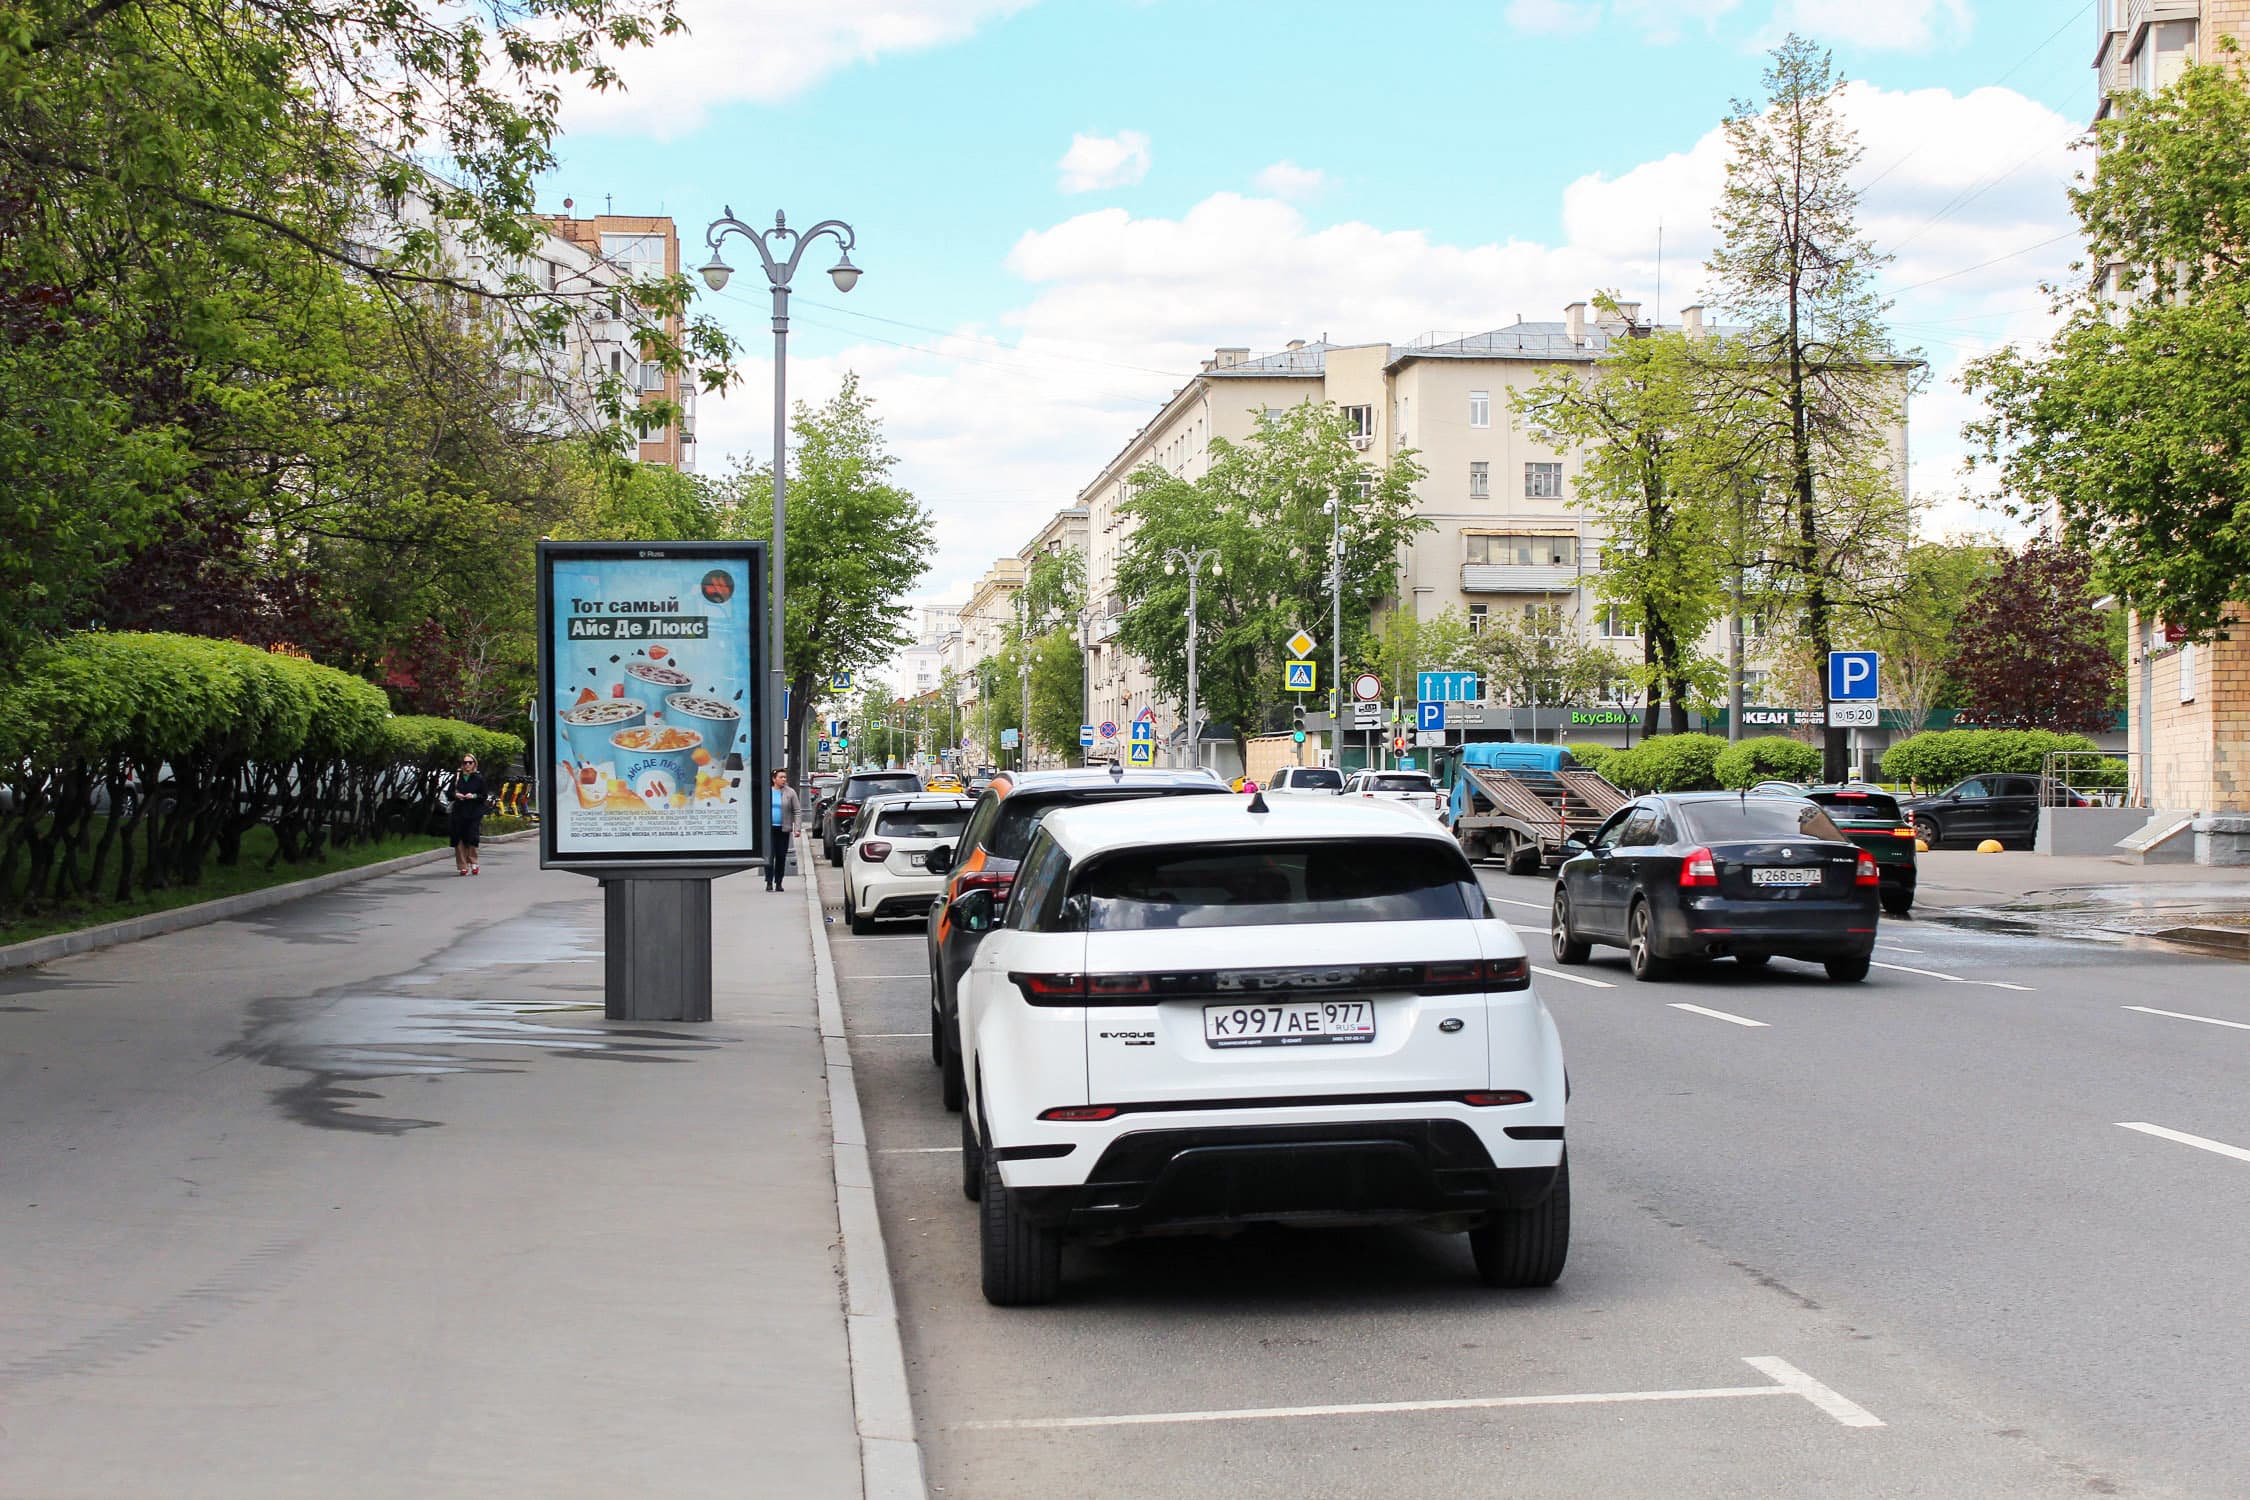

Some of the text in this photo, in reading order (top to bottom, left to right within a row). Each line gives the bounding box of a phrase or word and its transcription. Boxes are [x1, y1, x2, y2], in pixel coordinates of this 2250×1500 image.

[571, 596, 679, 613] Тот самый
[571, 619, 704, 638] Айс Де Люкс
[1843, 657, 1870, 695] P
[1424, 705, 1440, 728] P
[1743, 711, 1789, 724] КЕАН
[1835, 709, 1873, 720] 10 15 20
[642, 758, 657, 769] ДЕ
[1215, 1004, 1364, 1035] К997АЕ 977
[1100, 1031, 1155, 1039] EVOQUE
